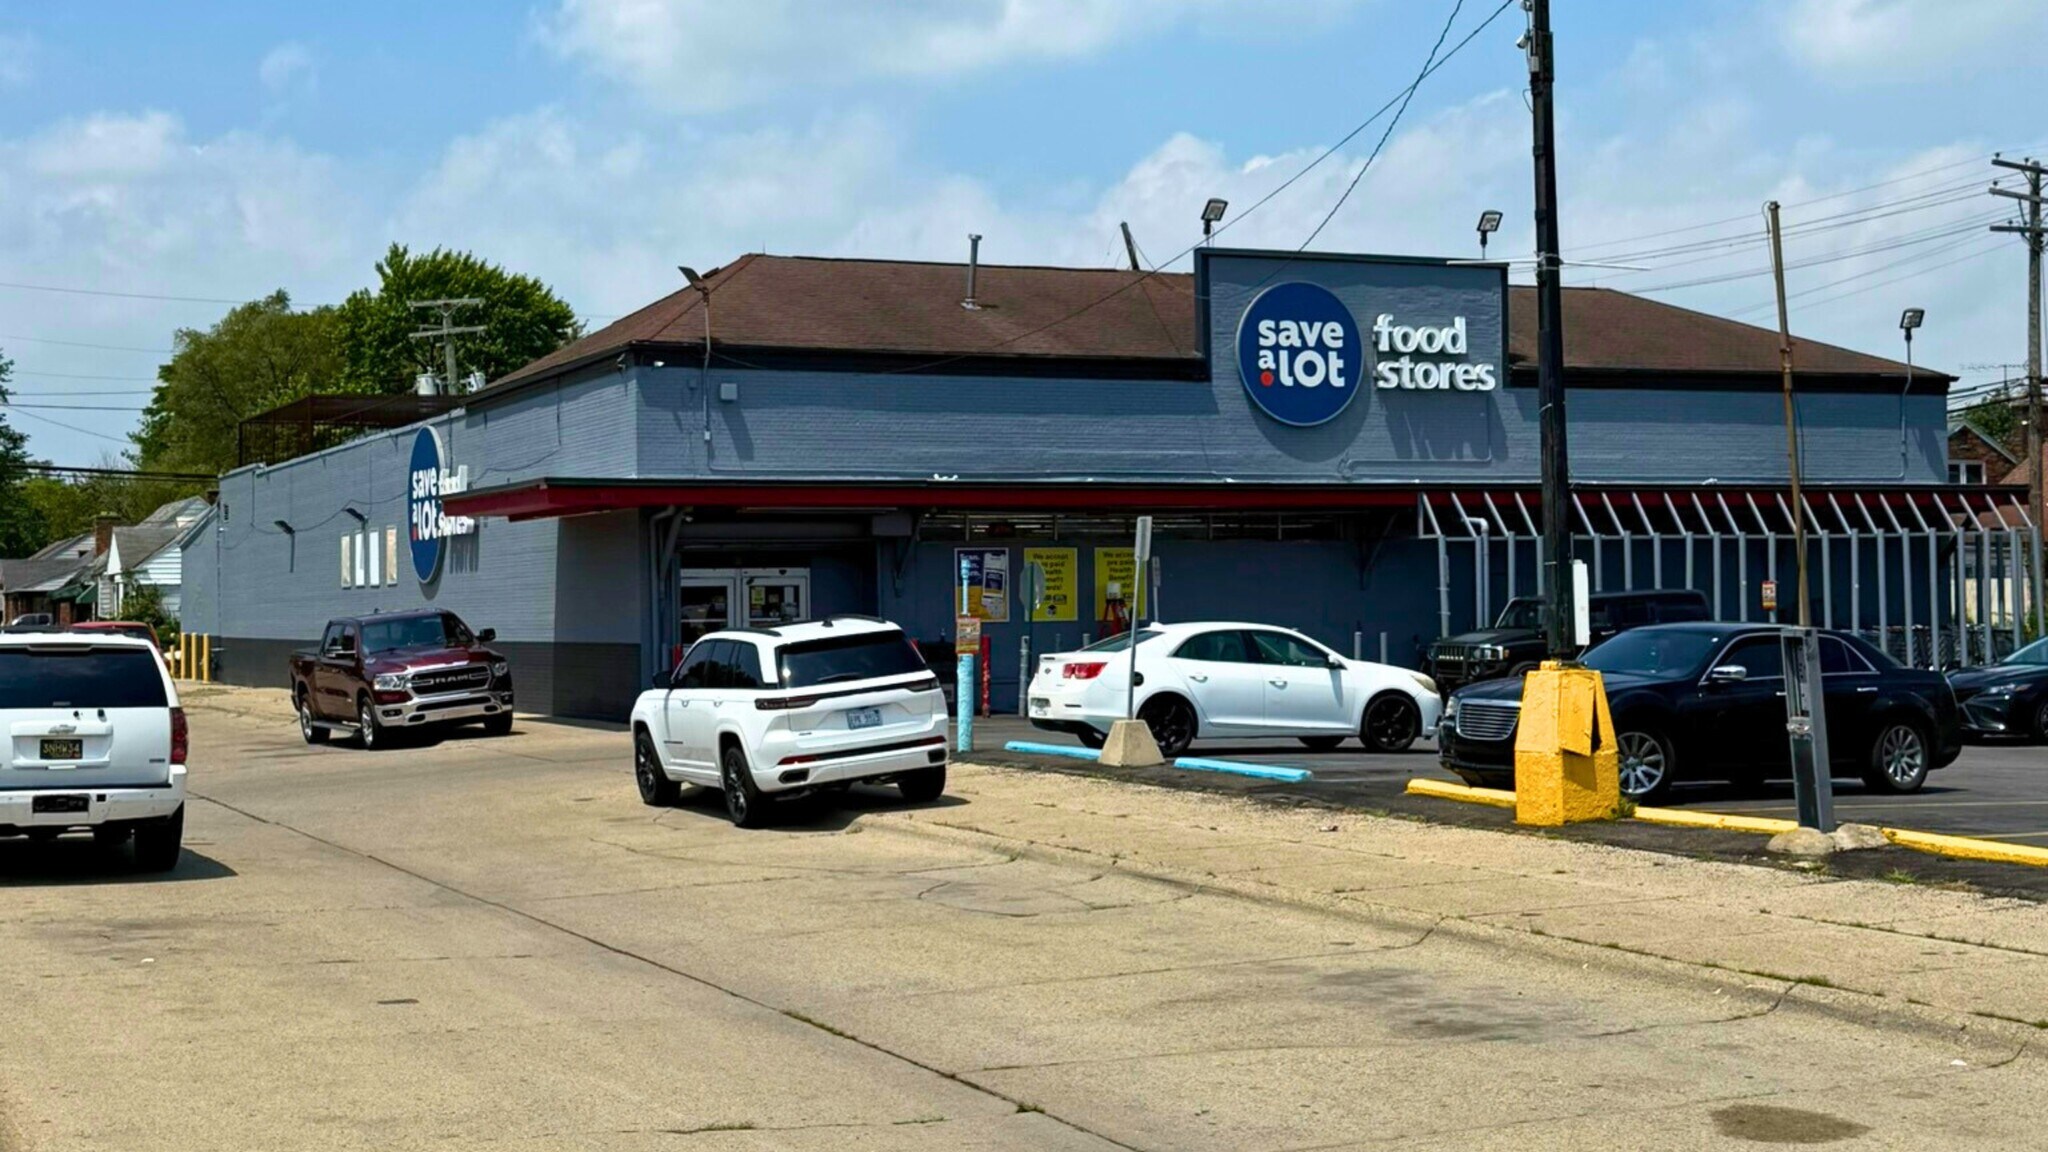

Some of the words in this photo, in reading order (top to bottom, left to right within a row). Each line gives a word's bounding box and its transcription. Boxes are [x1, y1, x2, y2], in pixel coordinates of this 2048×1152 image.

[1258, 320, 1344, 348] save
[1373, 313, 1467, 354] food
[1258, 350, 1276, 370] a
[1376, 355, 1496, 391] stores
[412, 467, 437, 499] save
[435, 674, 468, 684] RAM
